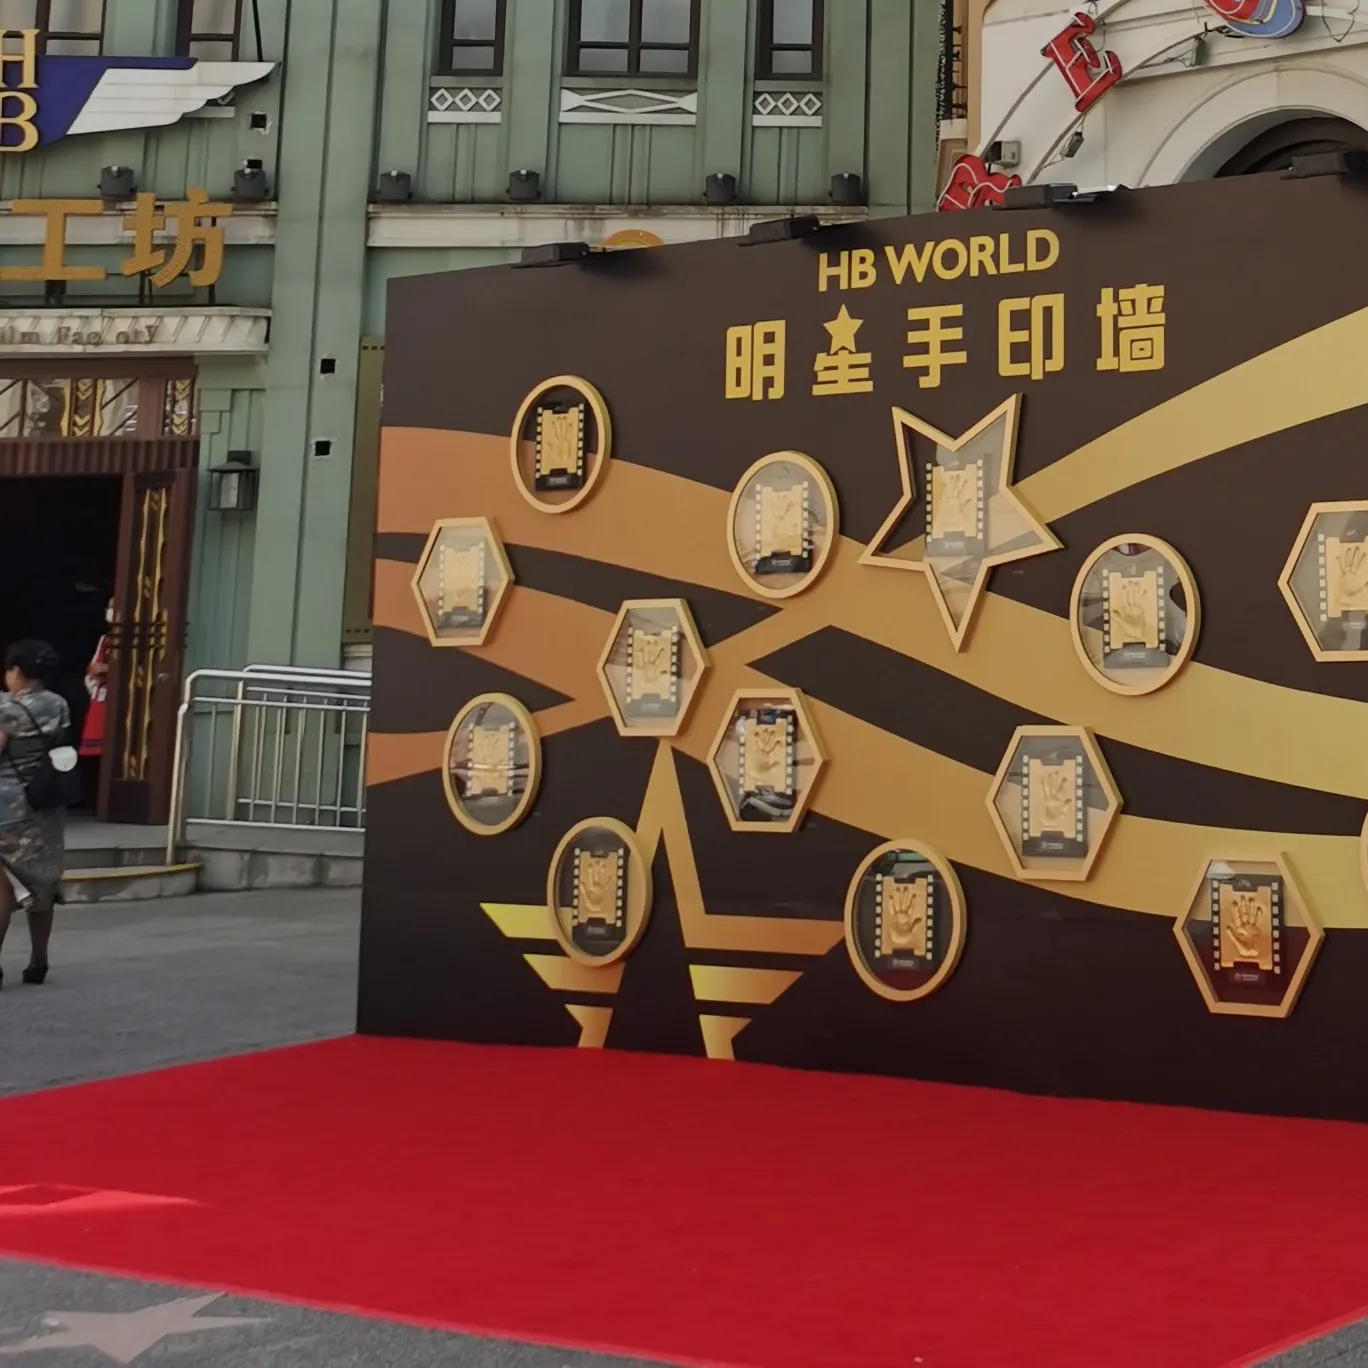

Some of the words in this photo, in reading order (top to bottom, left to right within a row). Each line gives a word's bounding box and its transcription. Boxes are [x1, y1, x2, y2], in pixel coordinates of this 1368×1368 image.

[0, 186, 233, 289] 工坊
[818, 248, 877, 292] HB
[884, 229, 1060, 285] WORLD
[724, 283, 1166, 401] 明星手印墙
